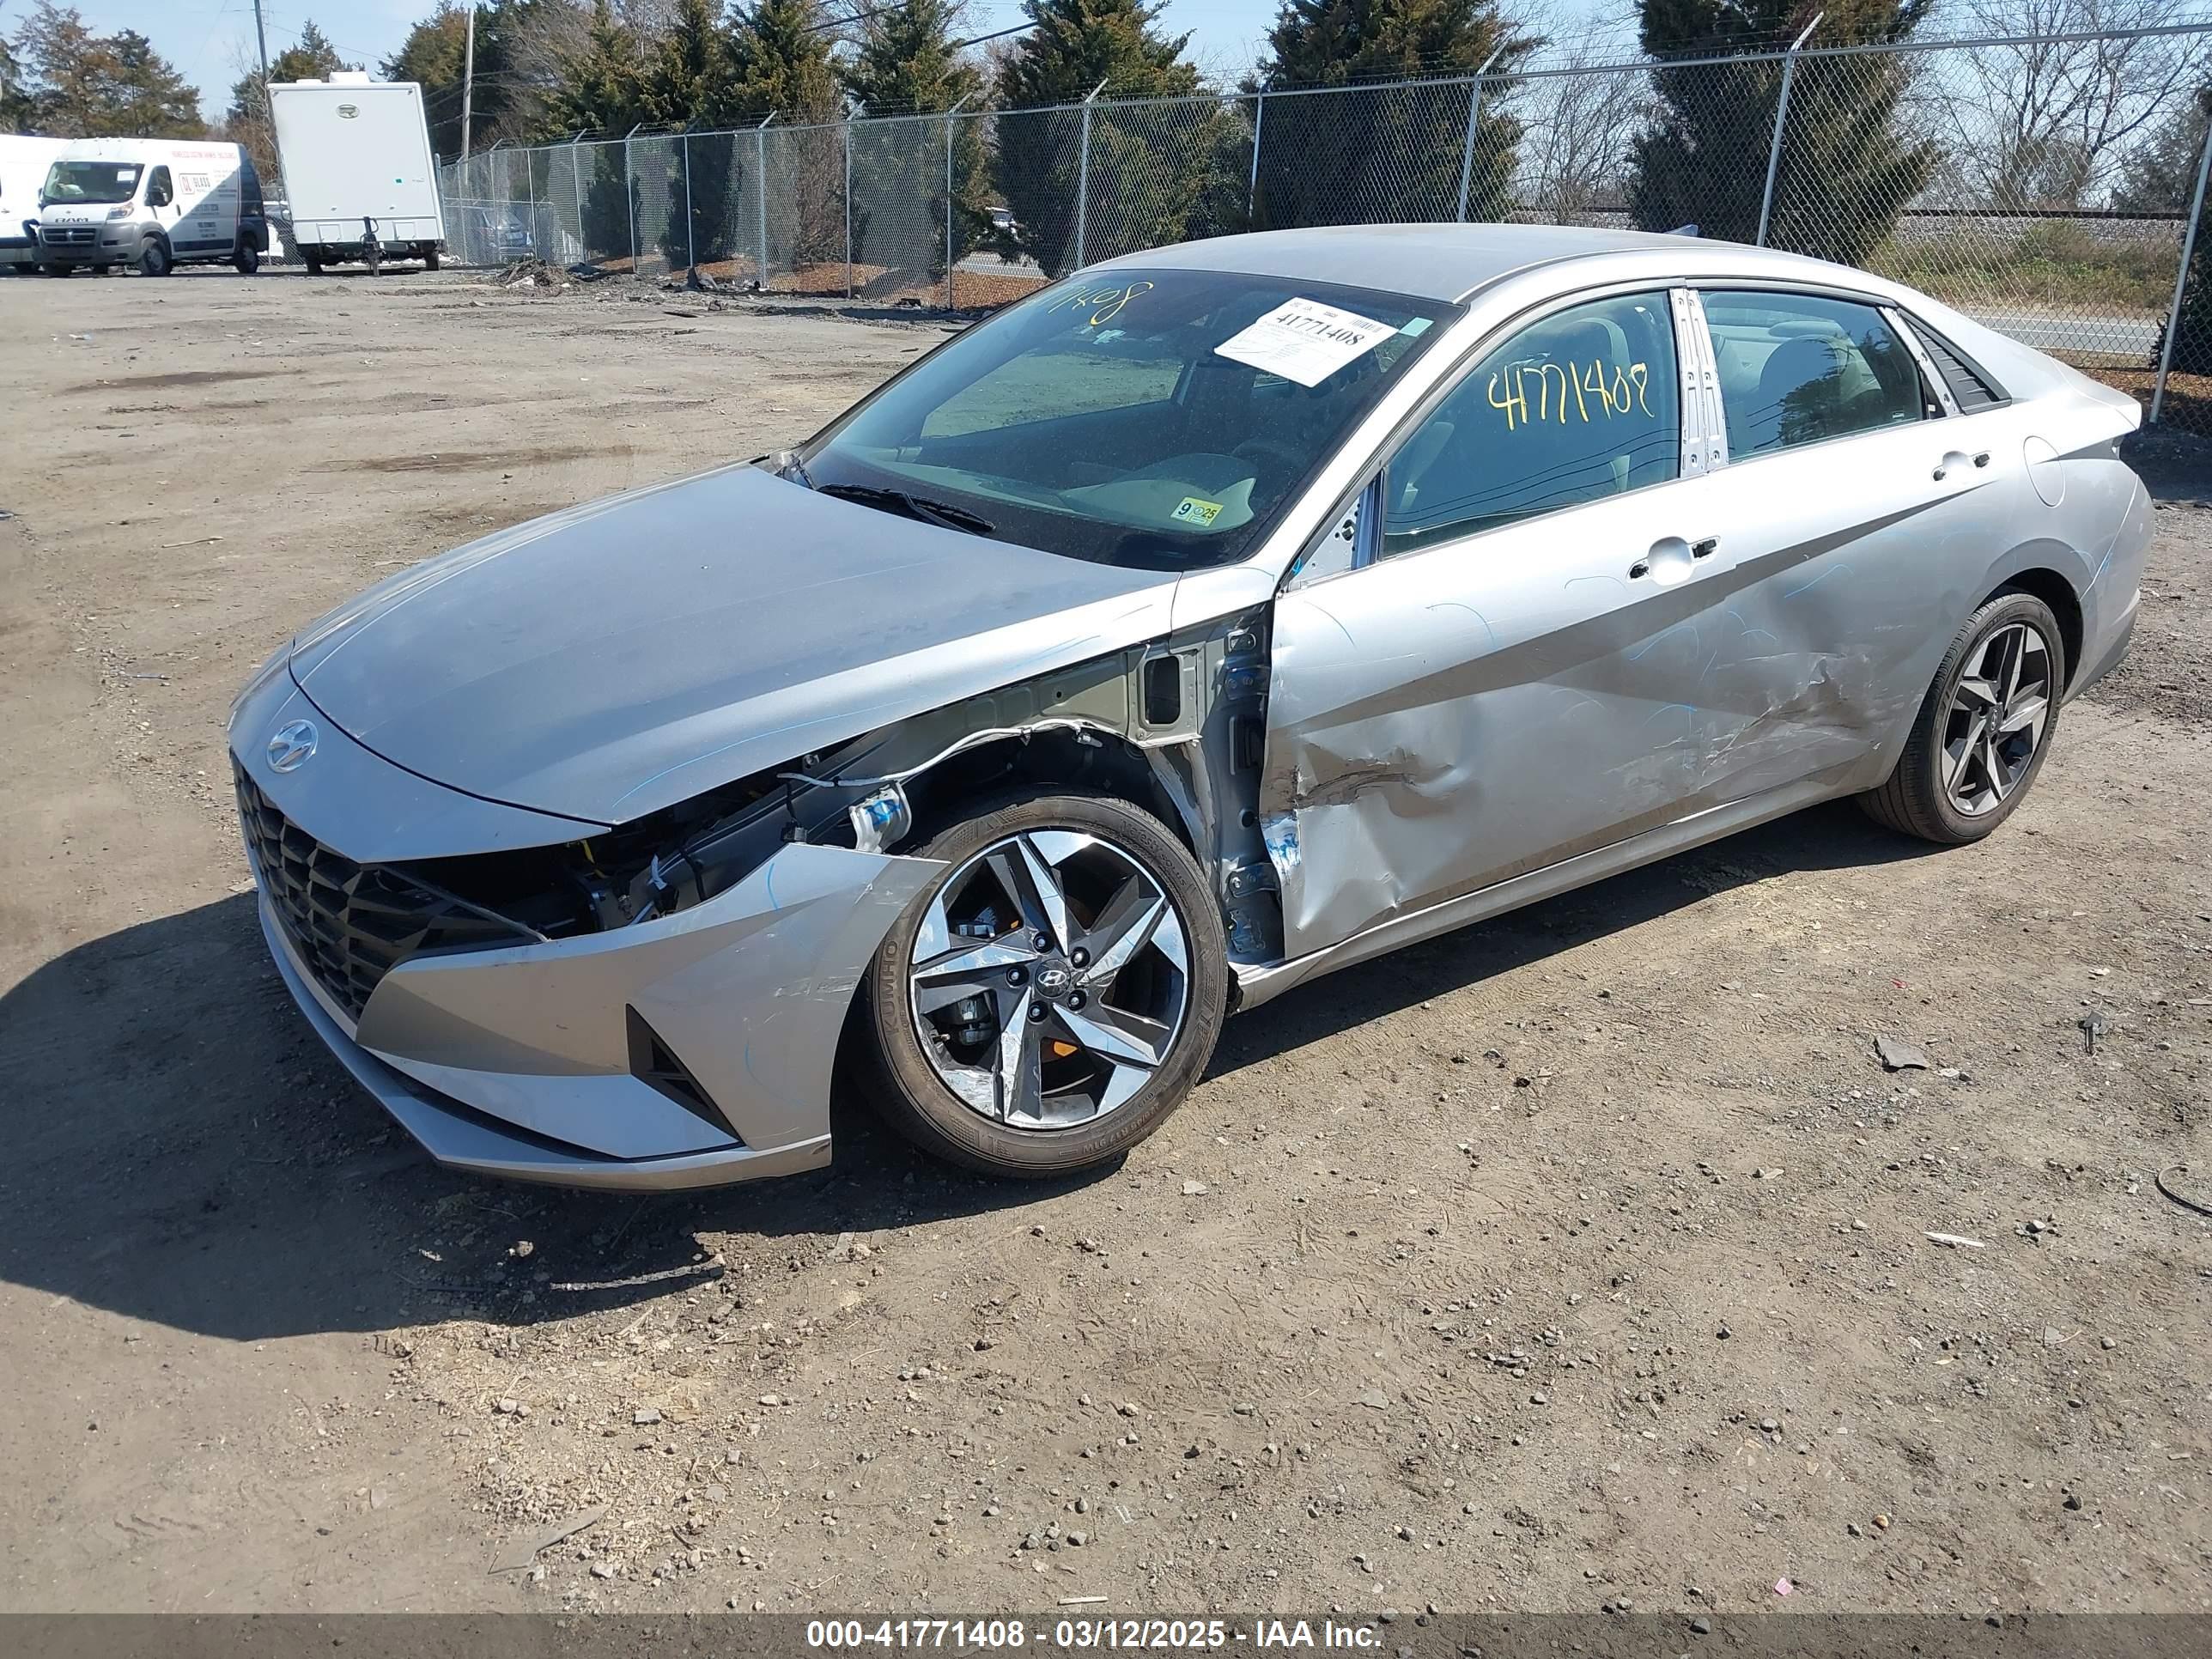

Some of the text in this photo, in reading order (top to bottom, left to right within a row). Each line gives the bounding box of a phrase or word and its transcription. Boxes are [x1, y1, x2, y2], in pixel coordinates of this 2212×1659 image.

[1275, 312, 1365, 346] 41771408
[1177, 502, 1218, 520] 9 25
[878, 939, 899, 1036] KUMHO
